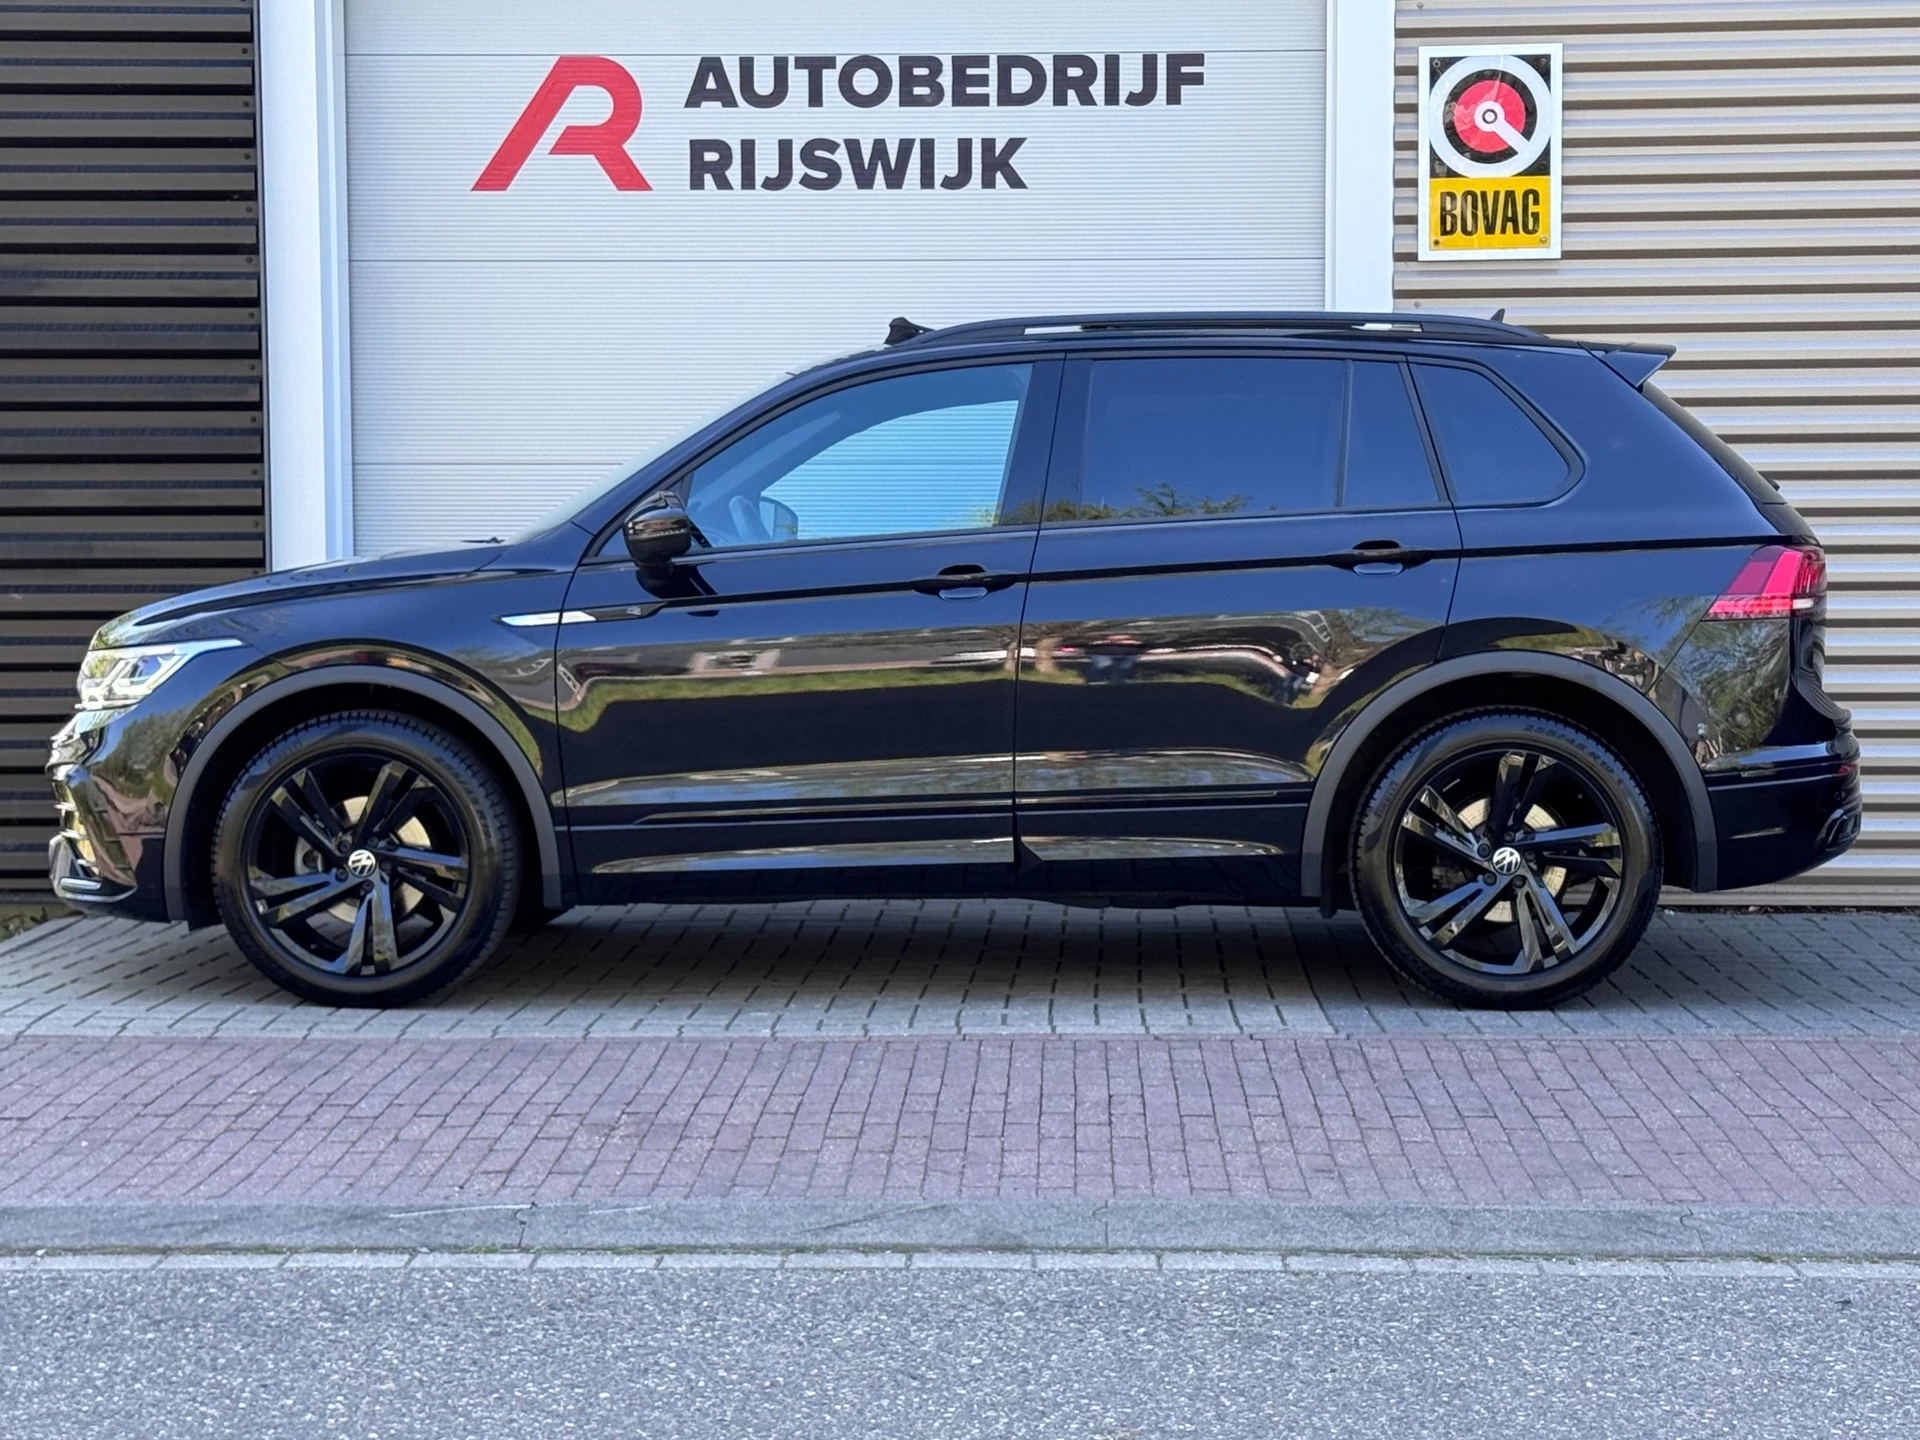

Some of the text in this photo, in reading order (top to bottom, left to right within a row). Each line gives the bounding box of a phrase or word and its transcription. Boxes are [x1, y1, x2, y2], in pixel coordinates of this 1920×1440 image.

[684, 53, 1206, 108] AUTOBEDRIJF
[690, 137, 1028, 190] RIJSWIJK
[1440, 188, 1541, 237] BOVAG
